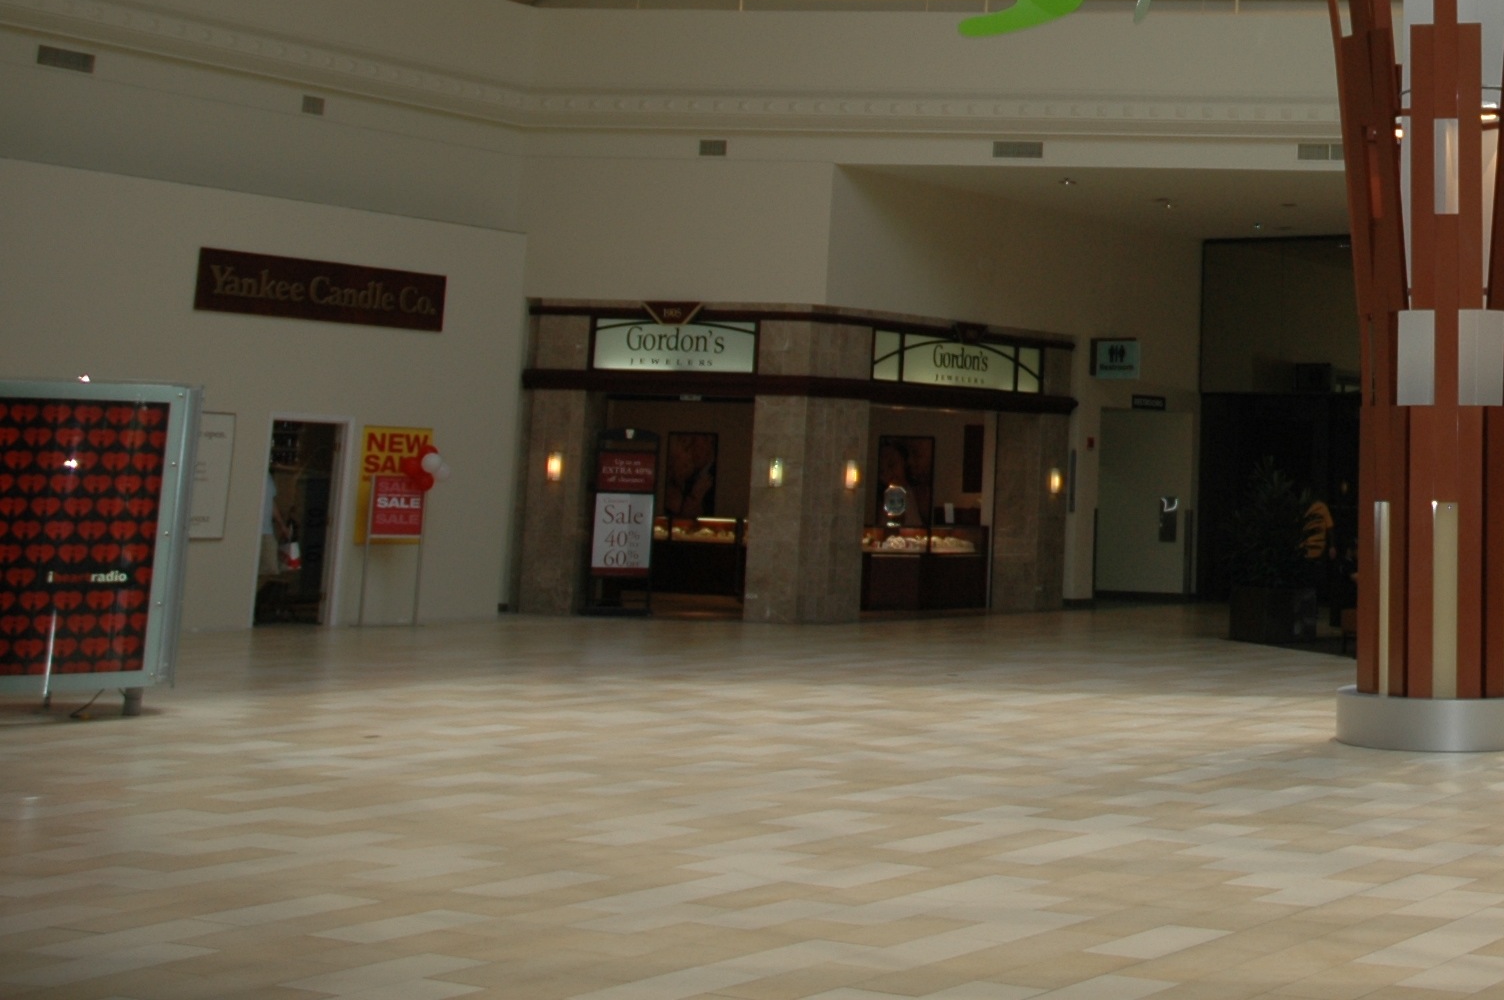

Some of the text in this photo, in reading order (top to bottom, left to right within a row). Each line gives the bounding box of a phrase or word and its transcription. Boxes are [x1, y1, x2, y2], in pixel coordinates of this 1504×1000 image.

[209, 263, 437, 316] Yankee Candle Co.
[626, 324, 725, 354] Gordon's
[630, 357, 713, 367] JEWELERS
[933, 343, 989, 372] Gordon's
[935, 373, 985, 384] JEWELERS
[366, 431, 430, 454] NEW
[602, 465, 632, 474] EXTRA
[377, 496, 421, 509] SALE
[376, 512, 419, 526] SALE
[602, 503, 644, 525] Sale
